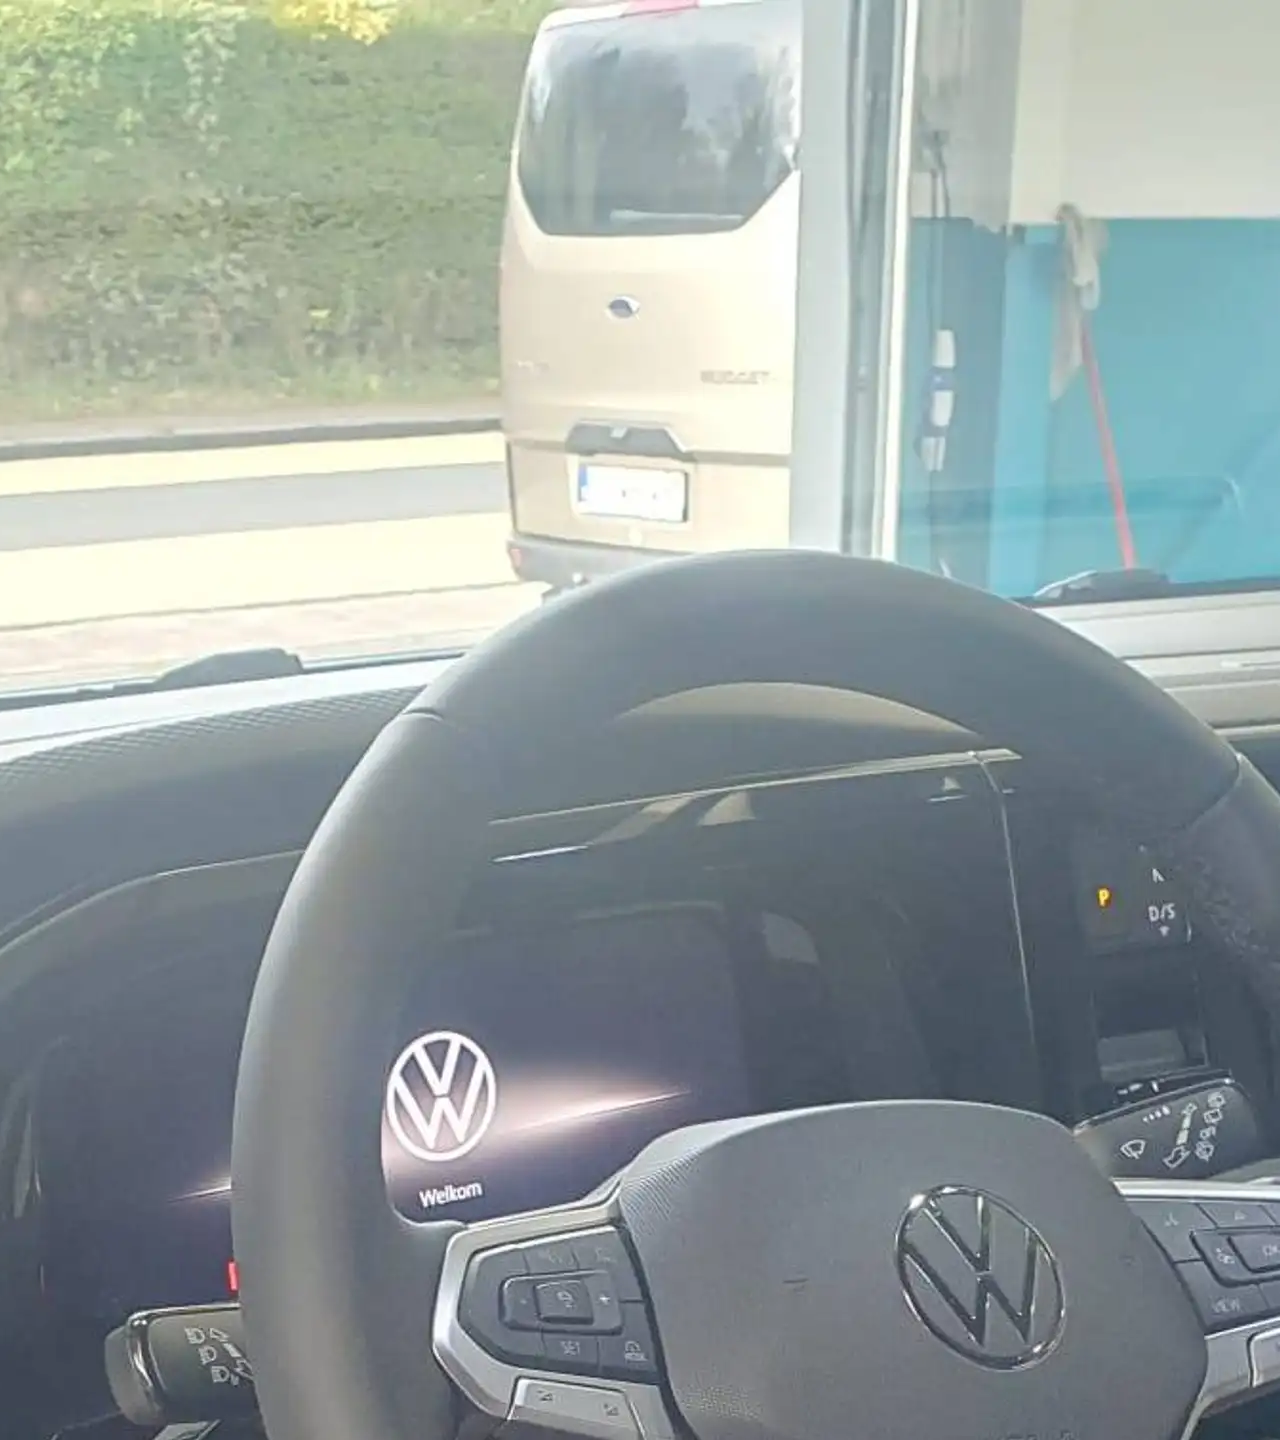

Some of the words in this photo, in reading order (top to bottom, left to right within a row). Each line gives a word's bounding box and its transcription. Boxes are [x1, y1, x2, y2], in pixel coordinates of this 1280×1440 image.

[1098, 887, 1111, 907] P
[1148, 902, 1176, 922] D/S
[419, 1182, 483, 1208] Welkom
